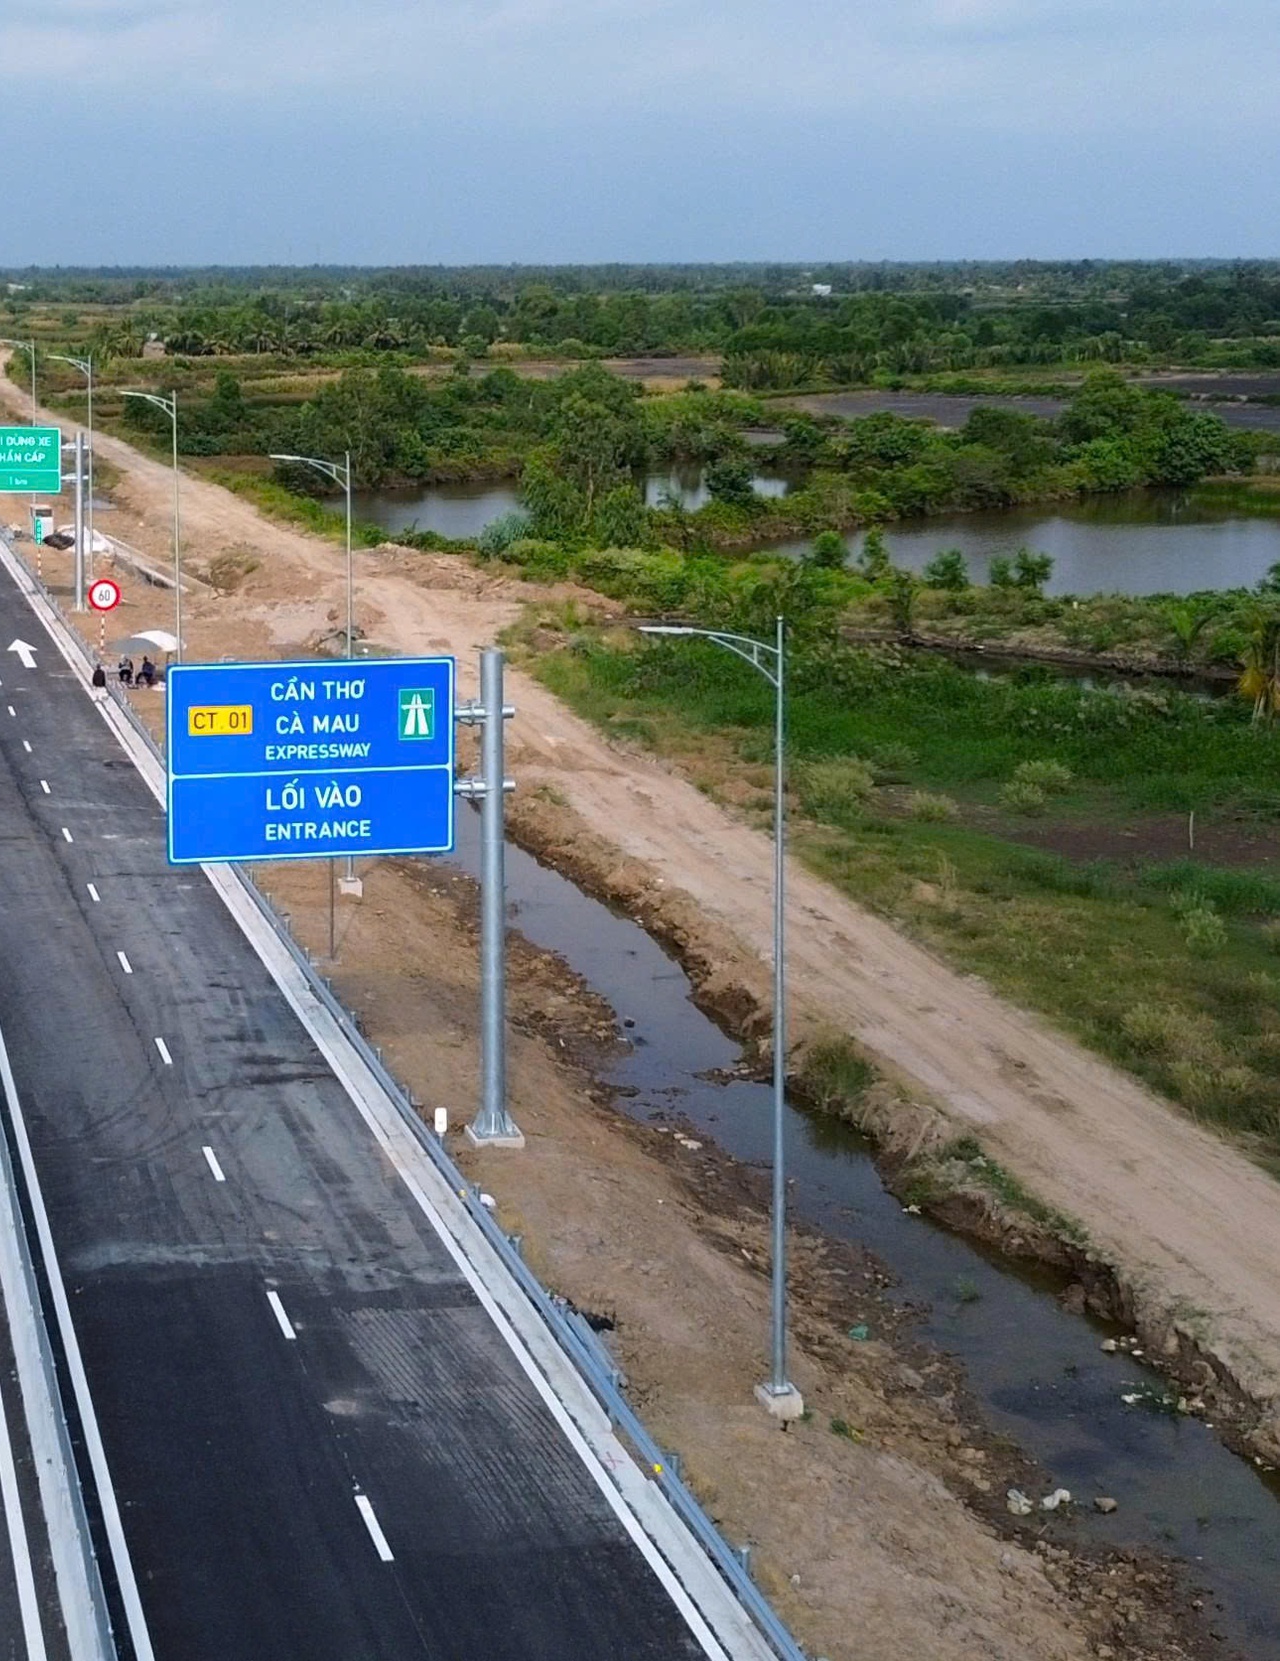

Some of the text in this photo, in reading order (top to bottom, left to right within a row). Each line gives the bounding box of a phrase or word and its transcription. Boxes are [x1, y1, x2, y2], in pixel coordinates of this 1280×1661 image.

[38, 436, 52, 446] XE
[98, 589, 111, 602] 60
[270, 676, 366, 701] CẦN THƠ
[229, 711, 247, 729] 01
[275, 710, 360, 735] CÀ MAU
[266, 743, 371, 760] EXPRESSWAY
[266, 778, 362, 811] LỐI VÀO
[266, 820, 371, 841] ENTRANCE
